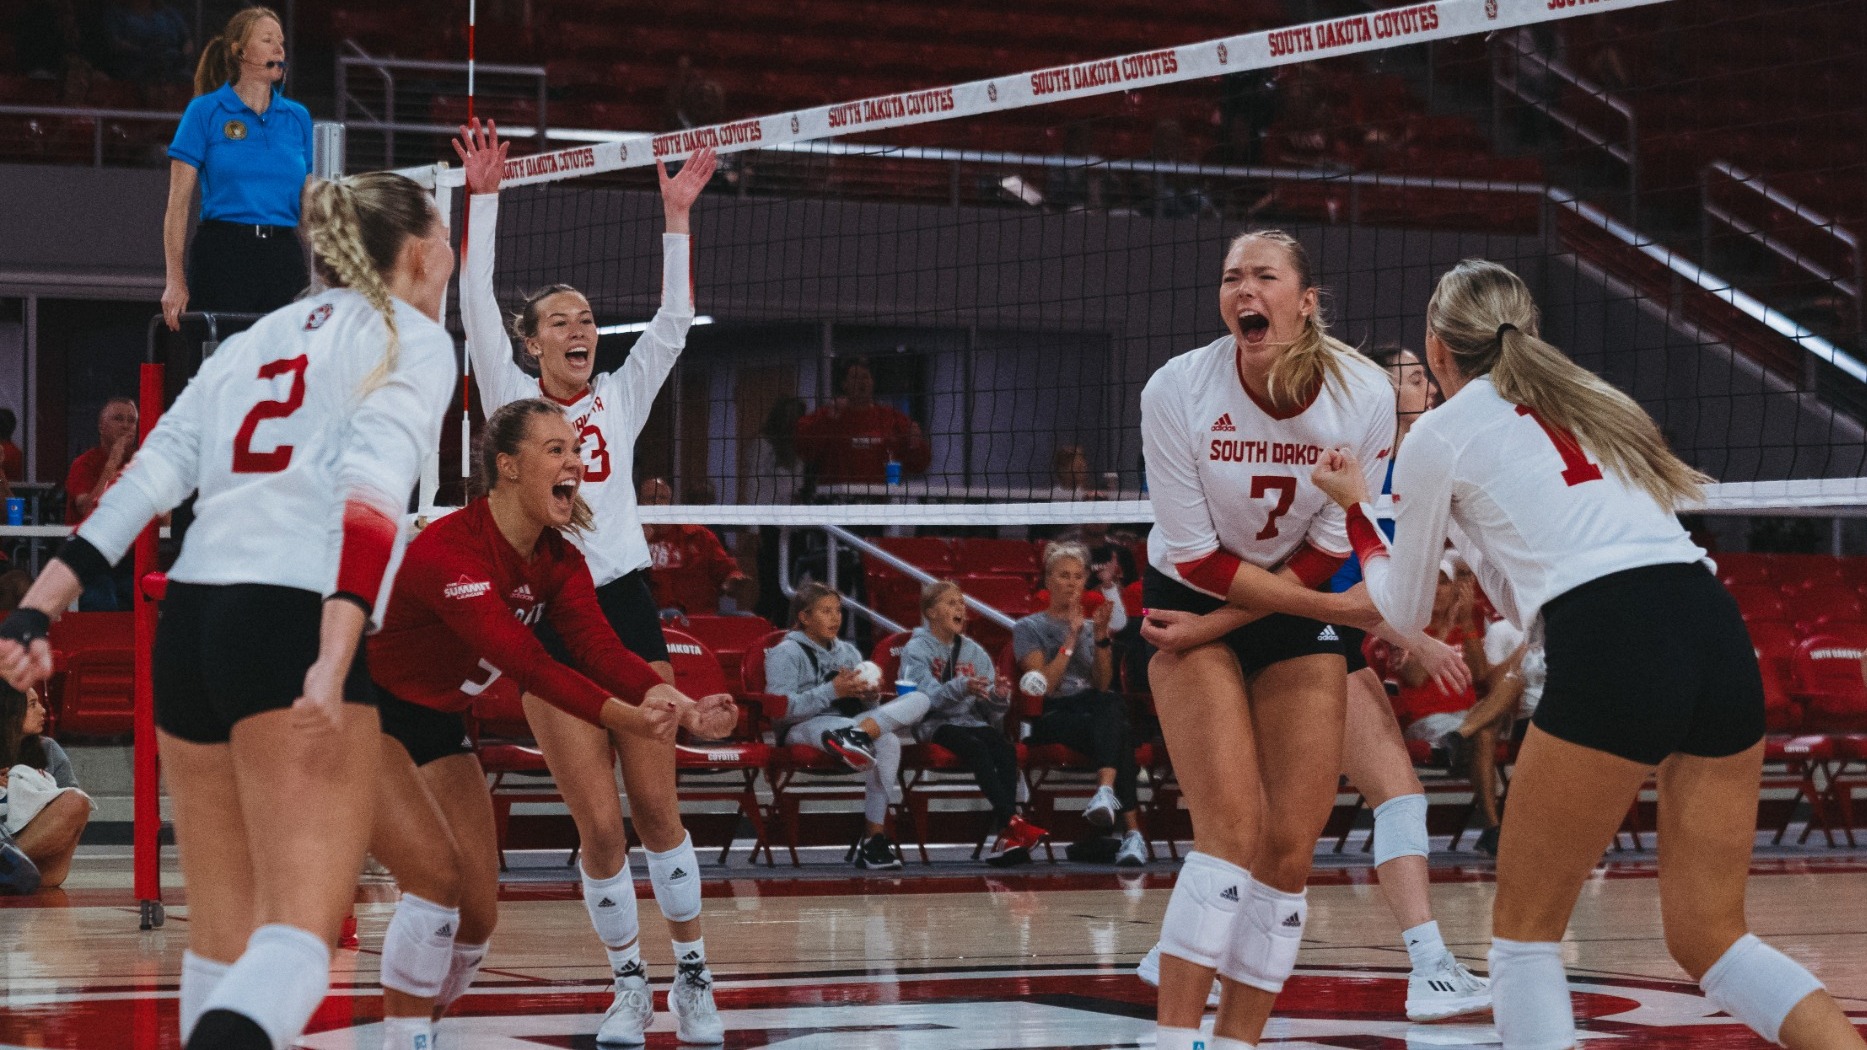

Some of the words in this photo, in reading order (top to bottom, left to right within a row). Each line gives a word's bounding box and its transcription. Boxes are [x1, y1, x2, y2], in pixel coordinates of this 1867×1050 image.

[1268, 27, 1313, 57] SOUTH
[1316, 17, 1372, 49] DAKOTA
[1374, 4, 1439, 39] COYOTES
[1031, 67, 1071, 95] SOUTH
[1073, 60, 1121, 89] DAKOTA
[1122, 50, 1178, 80] COYOTES
[828, 102, 862, 128] SOUTH
[864, 94, 906, 122] DAKOTA
[906, 88, 954, 116] COYOTES
[652, 134, 681, 157] SOUTH
[683, 127, 719, 151] DAKOTA
[719, 120, 762, 146] COYOTES
[501, 160, 525, 180] OUTH
[526, 154, 559, 176] DAKOTA
[558, 147, 595, 172] COYOTES
[231, 353, 309, 473] 2
[1210, 424, 1236, 432] adidas
[1209, 439, 1268, 463] SOUTH
[1272, 443, 1324, 465] DAKO
[1514, 403, 1604, 487] 1
[1250, 475, 1297, 541] 7
[444, 581, 491, 598] SUMMIT
